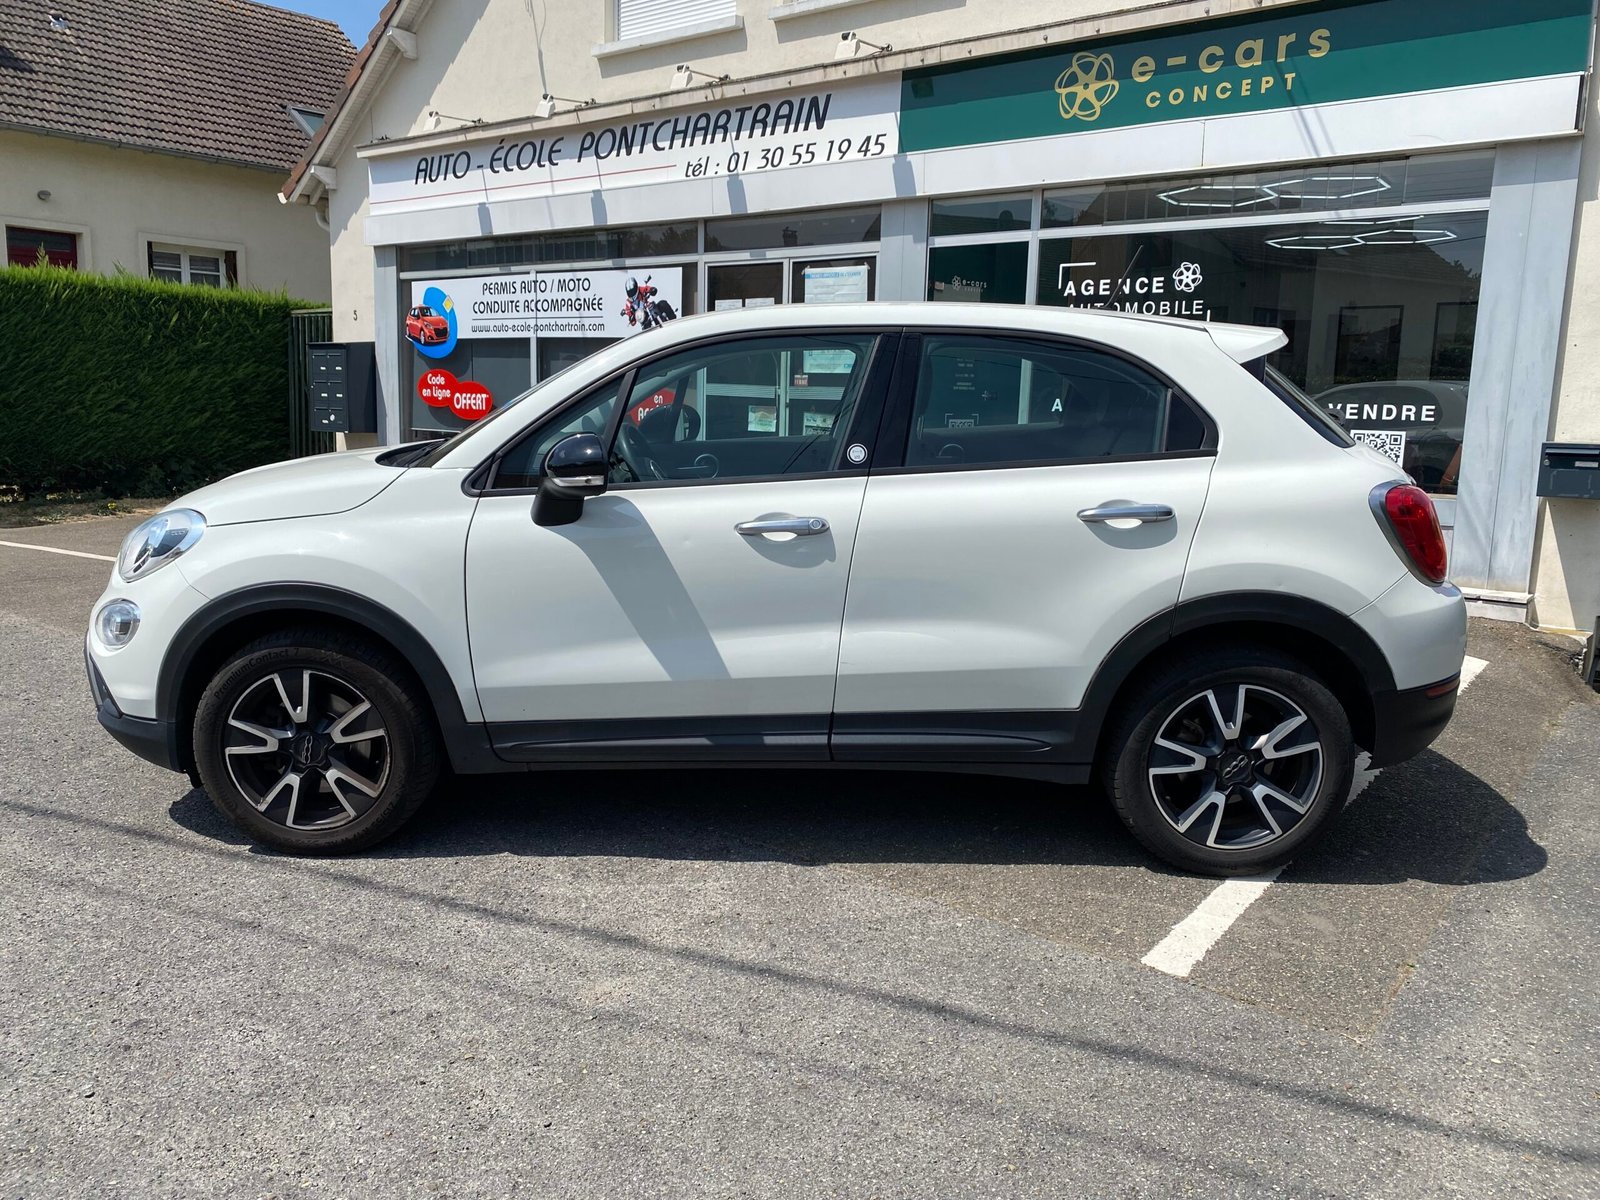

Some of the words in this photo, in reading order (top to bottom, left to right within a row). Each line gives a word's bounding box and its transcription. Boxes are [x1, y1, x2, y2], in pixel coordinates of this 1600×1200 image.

[1131, 28, 1331, 83] e-cars
[1145, 73, 1296, 108] CONCEPT
[415, 150, 471, 185] AUTO
[489, 137, 564, 174] ÉCOLE
[577, 93, 832, 163] PONTCHARTRAIN
[727, 151, 750, 174] 01
[757, 146, 785, 170] 30
[789, 141, 817, 166] 55
[826, 137, 852, 162] 19
[858, 133, 888, 157] 45
[482, 280, 517, 296] PERMIS
[520, 279, 547, 294] AUTO
[557, 277, 591, 292] MOTO
[1063, 276, 1165, 297] AGENCE
[472, 299, 520, 315] CONDUITE
[523, 293, 603, 313] ACCOMPAGNÉE
[352, 309, 358, 321] 5
[471, 320, 605, 335] www.auto-ecole-pontchartrain.com
[427, 373, 446, 385] Code
[422, 388, 432, 397] en
[432, 386, 451, 400] Ligne
[653, 394, 664, 404] en
[1051, 398, 1063, 412] A
